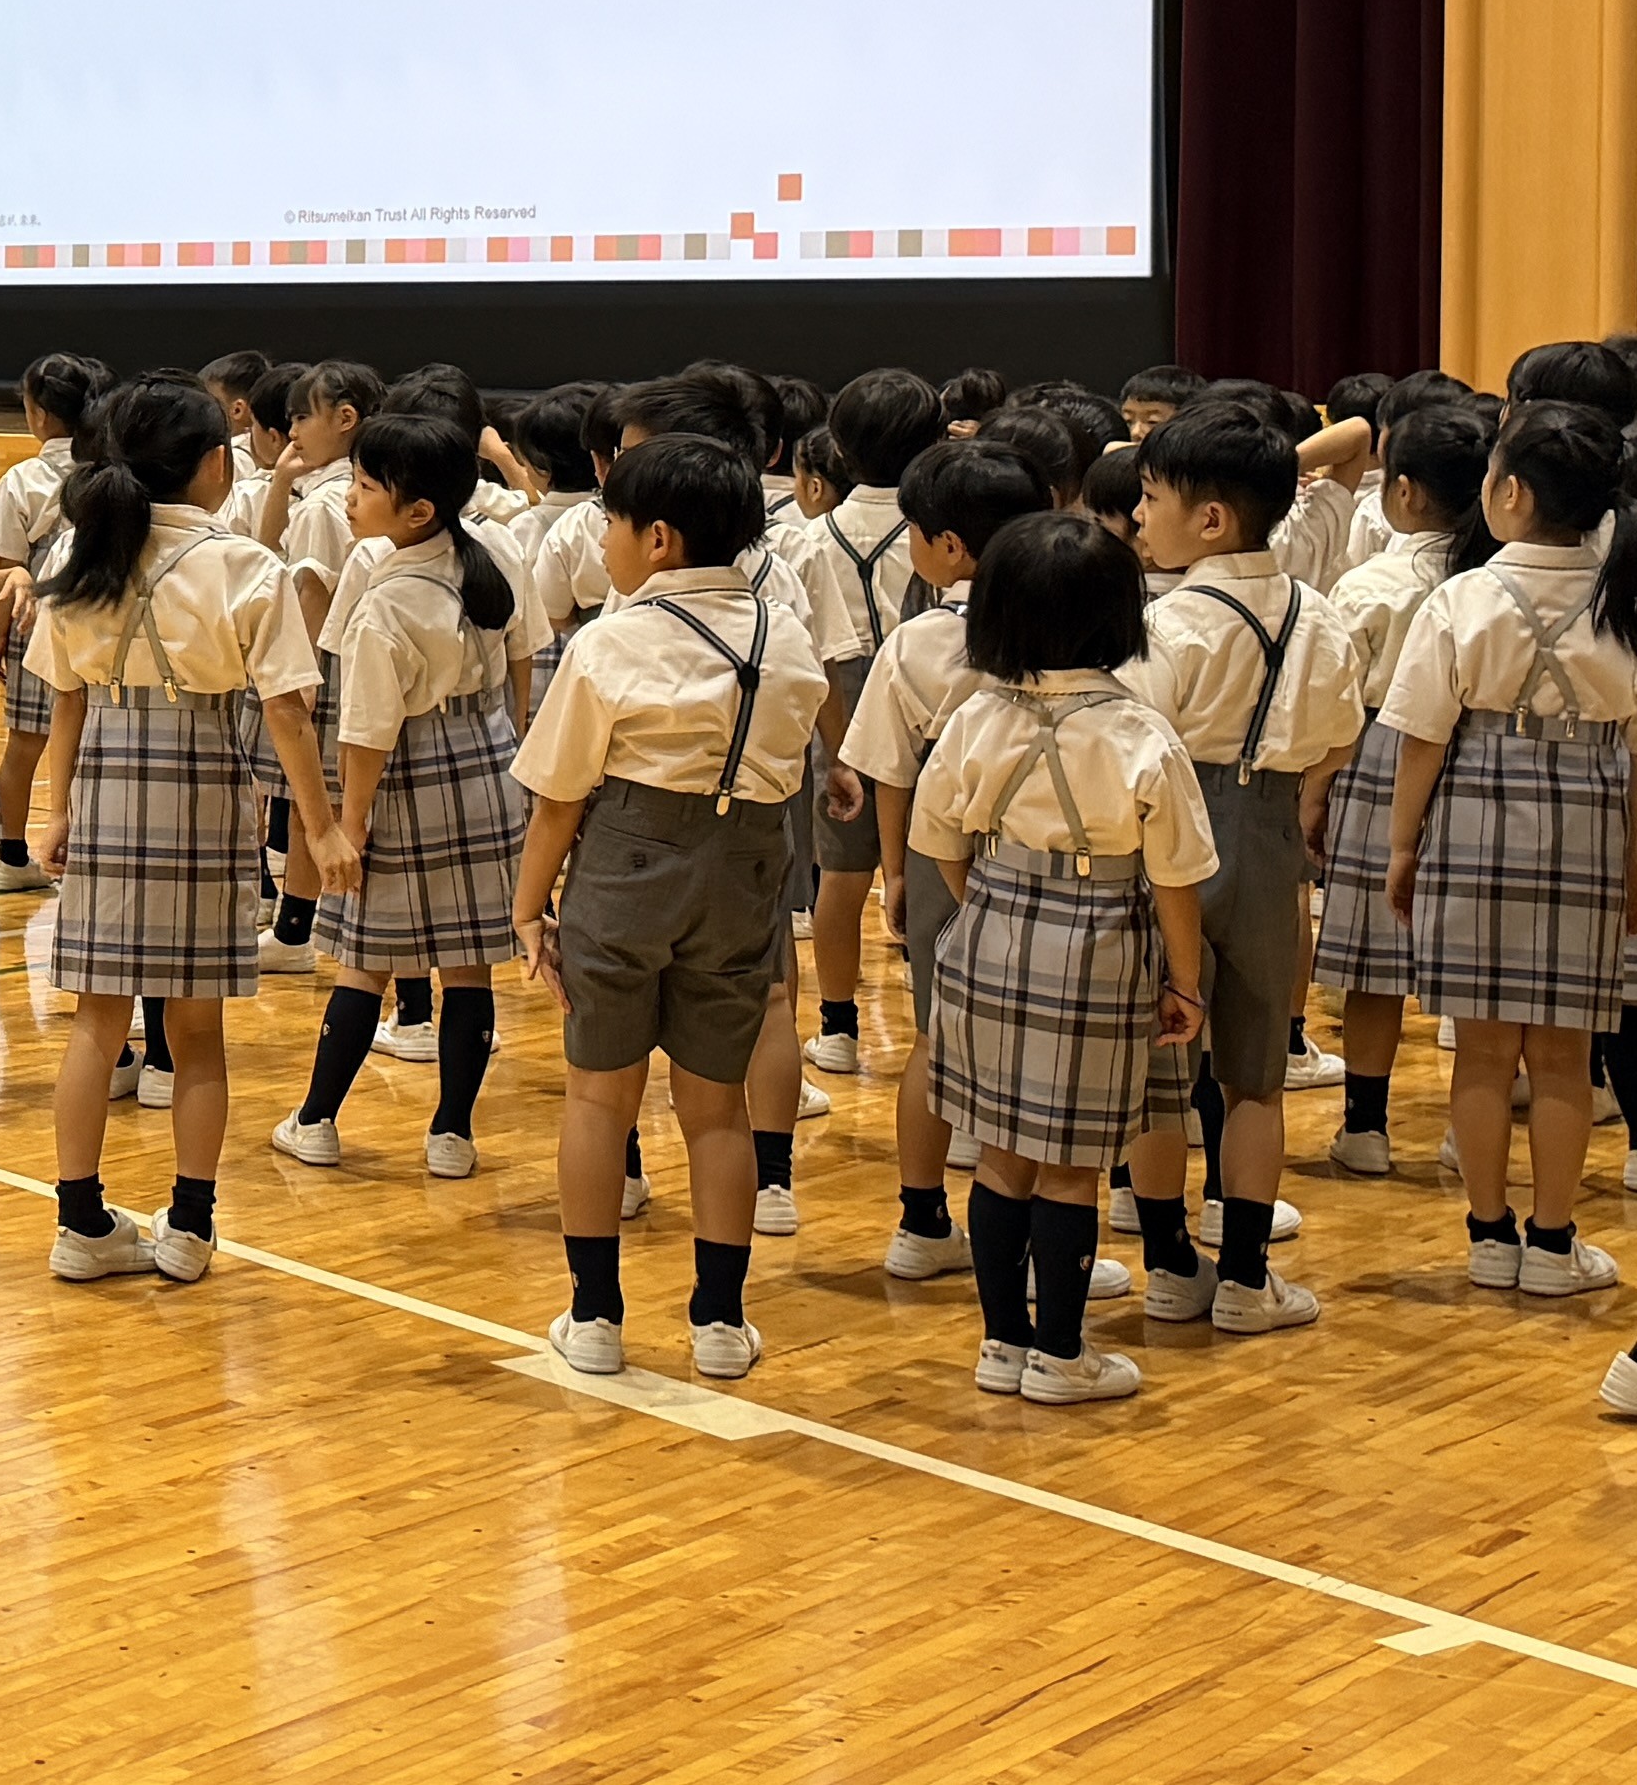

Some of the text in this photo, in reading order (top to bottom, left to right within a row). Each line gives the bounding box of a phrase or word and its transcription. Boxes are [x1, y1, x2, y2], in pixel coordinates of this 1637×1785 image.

[298, 209, 372, 224] Ritsumeikan
[375, 208, 408, 222] Trust
[410, 207, 427, 222] All
[429, 206, 471, 224] Rights
[474, 204, 537, 220] Reserved
